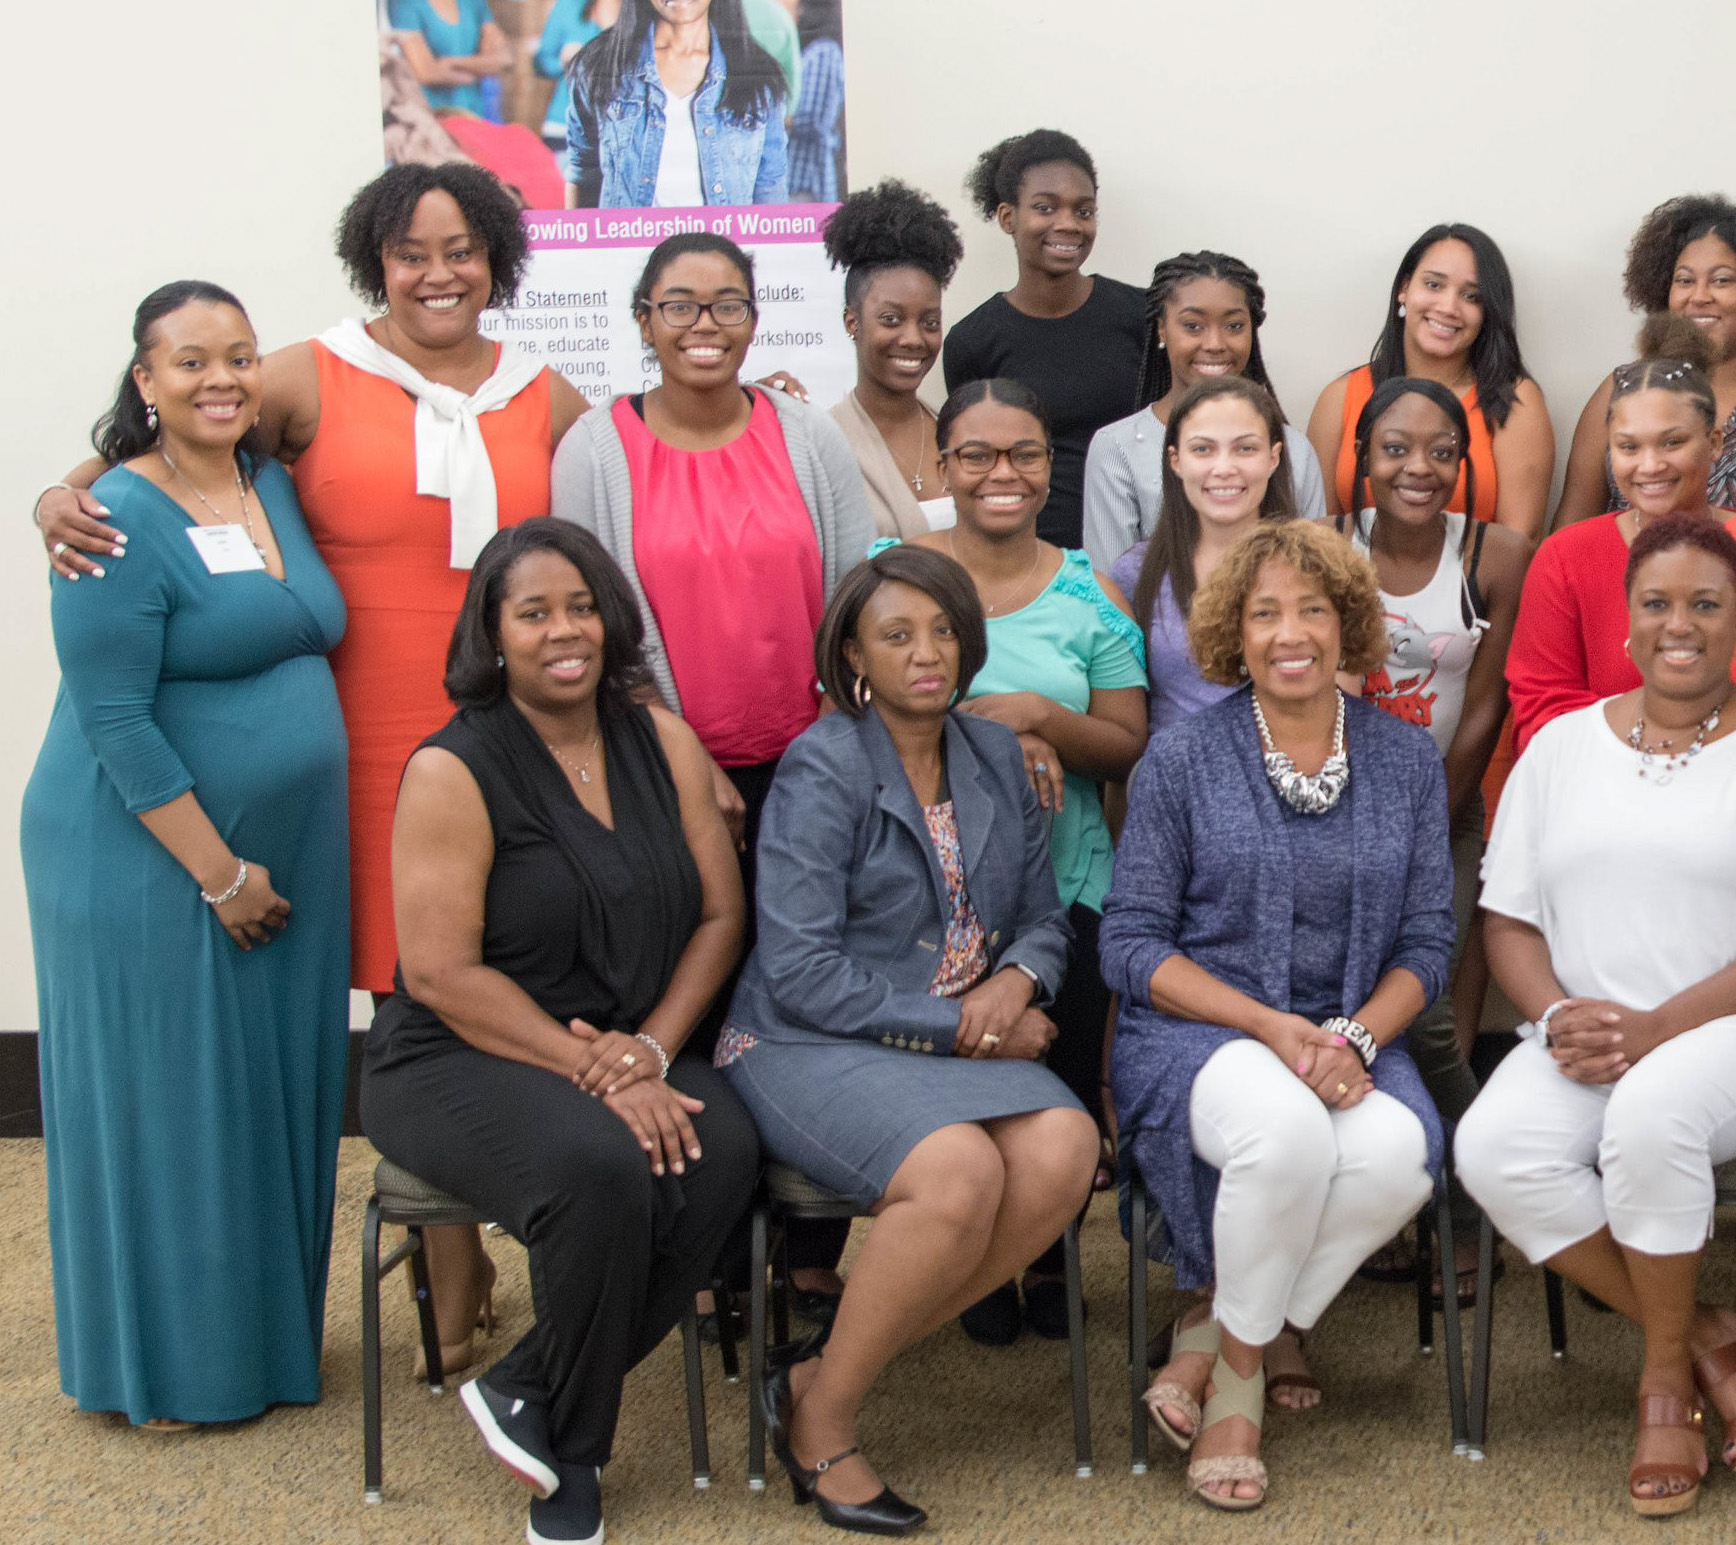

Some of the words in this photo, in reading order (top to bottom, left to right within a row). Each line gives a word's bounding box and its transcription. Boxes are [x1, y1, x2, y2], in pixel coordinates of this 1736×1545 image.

[527, 218, 588, 243] owing
[595, 215, 706, 239] Leadership
[712, 214, 732, 236] of
[737, 213, 815, 235] Women
[526, 290, 608, 307] Statement
[757, 284, 804, 300] clude:
[505, 314, 568, 331] mission
[575, 312, 587, 329] is
[593, 313, 608, 329] to
[548, 336, 610, 353] educate
[752, 329, 823, 347] orkshops
